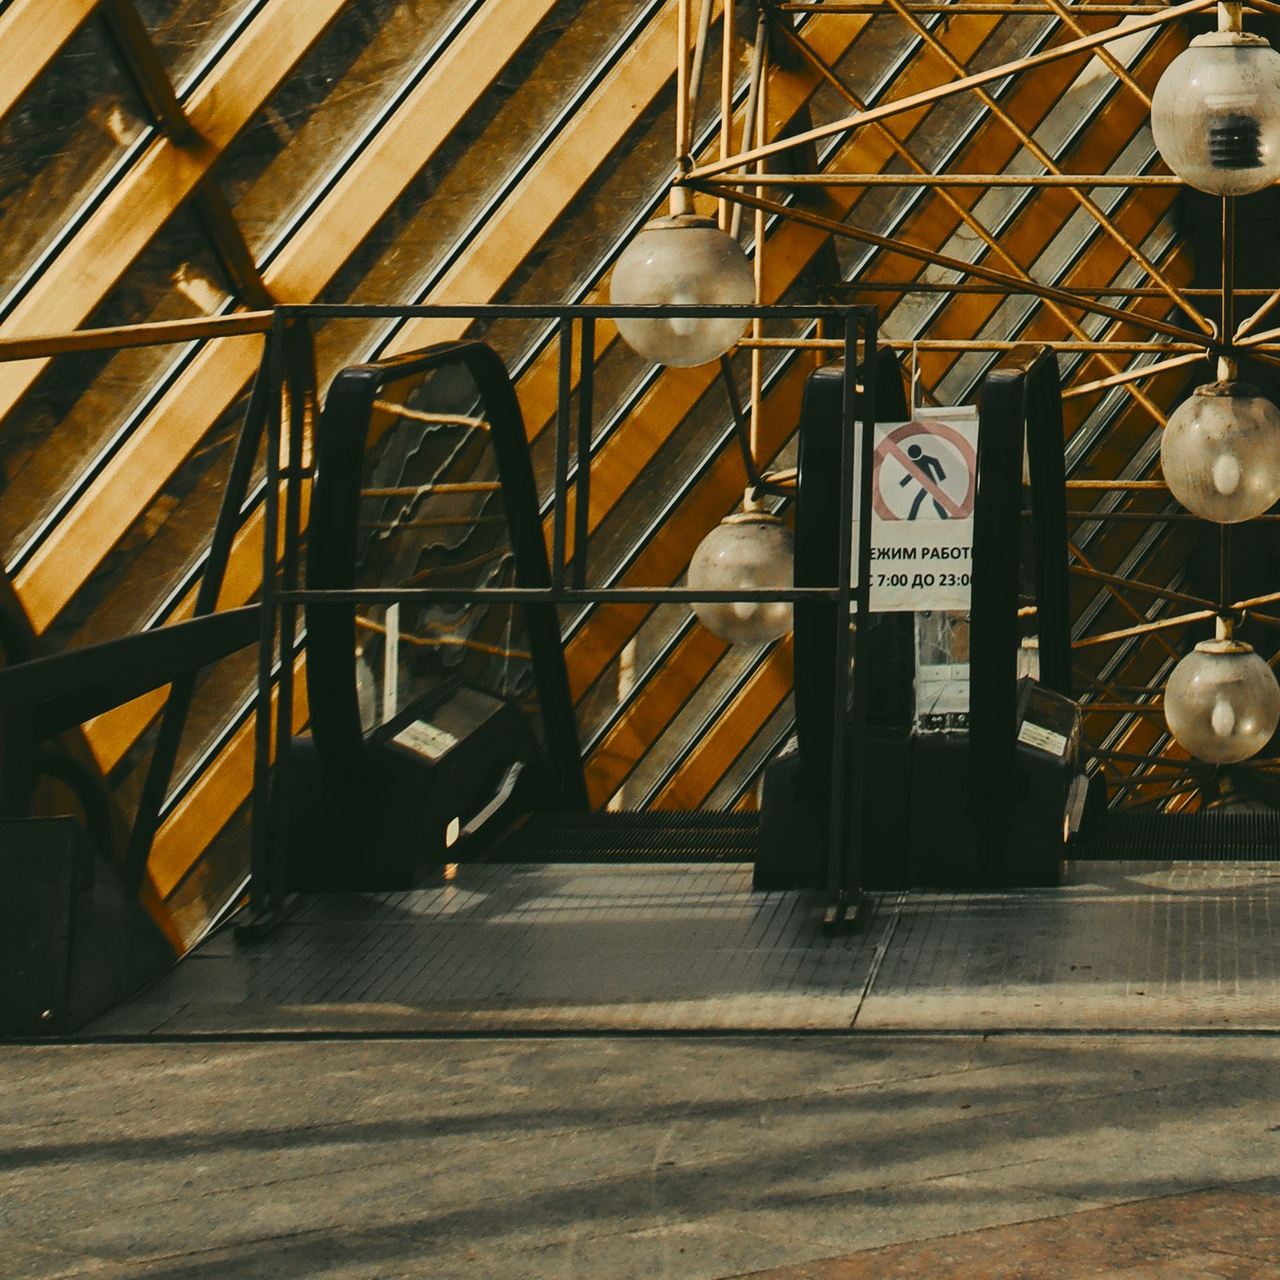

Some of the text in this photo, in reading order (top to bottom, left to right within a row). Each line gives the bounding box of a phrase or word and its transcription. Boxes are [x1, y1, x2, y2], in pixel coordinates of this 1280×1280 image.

[870, 547, 973, 560] ЕЖИМ РАБОТ
[877, 574, 908, 587] 7:00
[911, 574, 935, 589] ДО
[938, 573, 973, 587] 23:0
